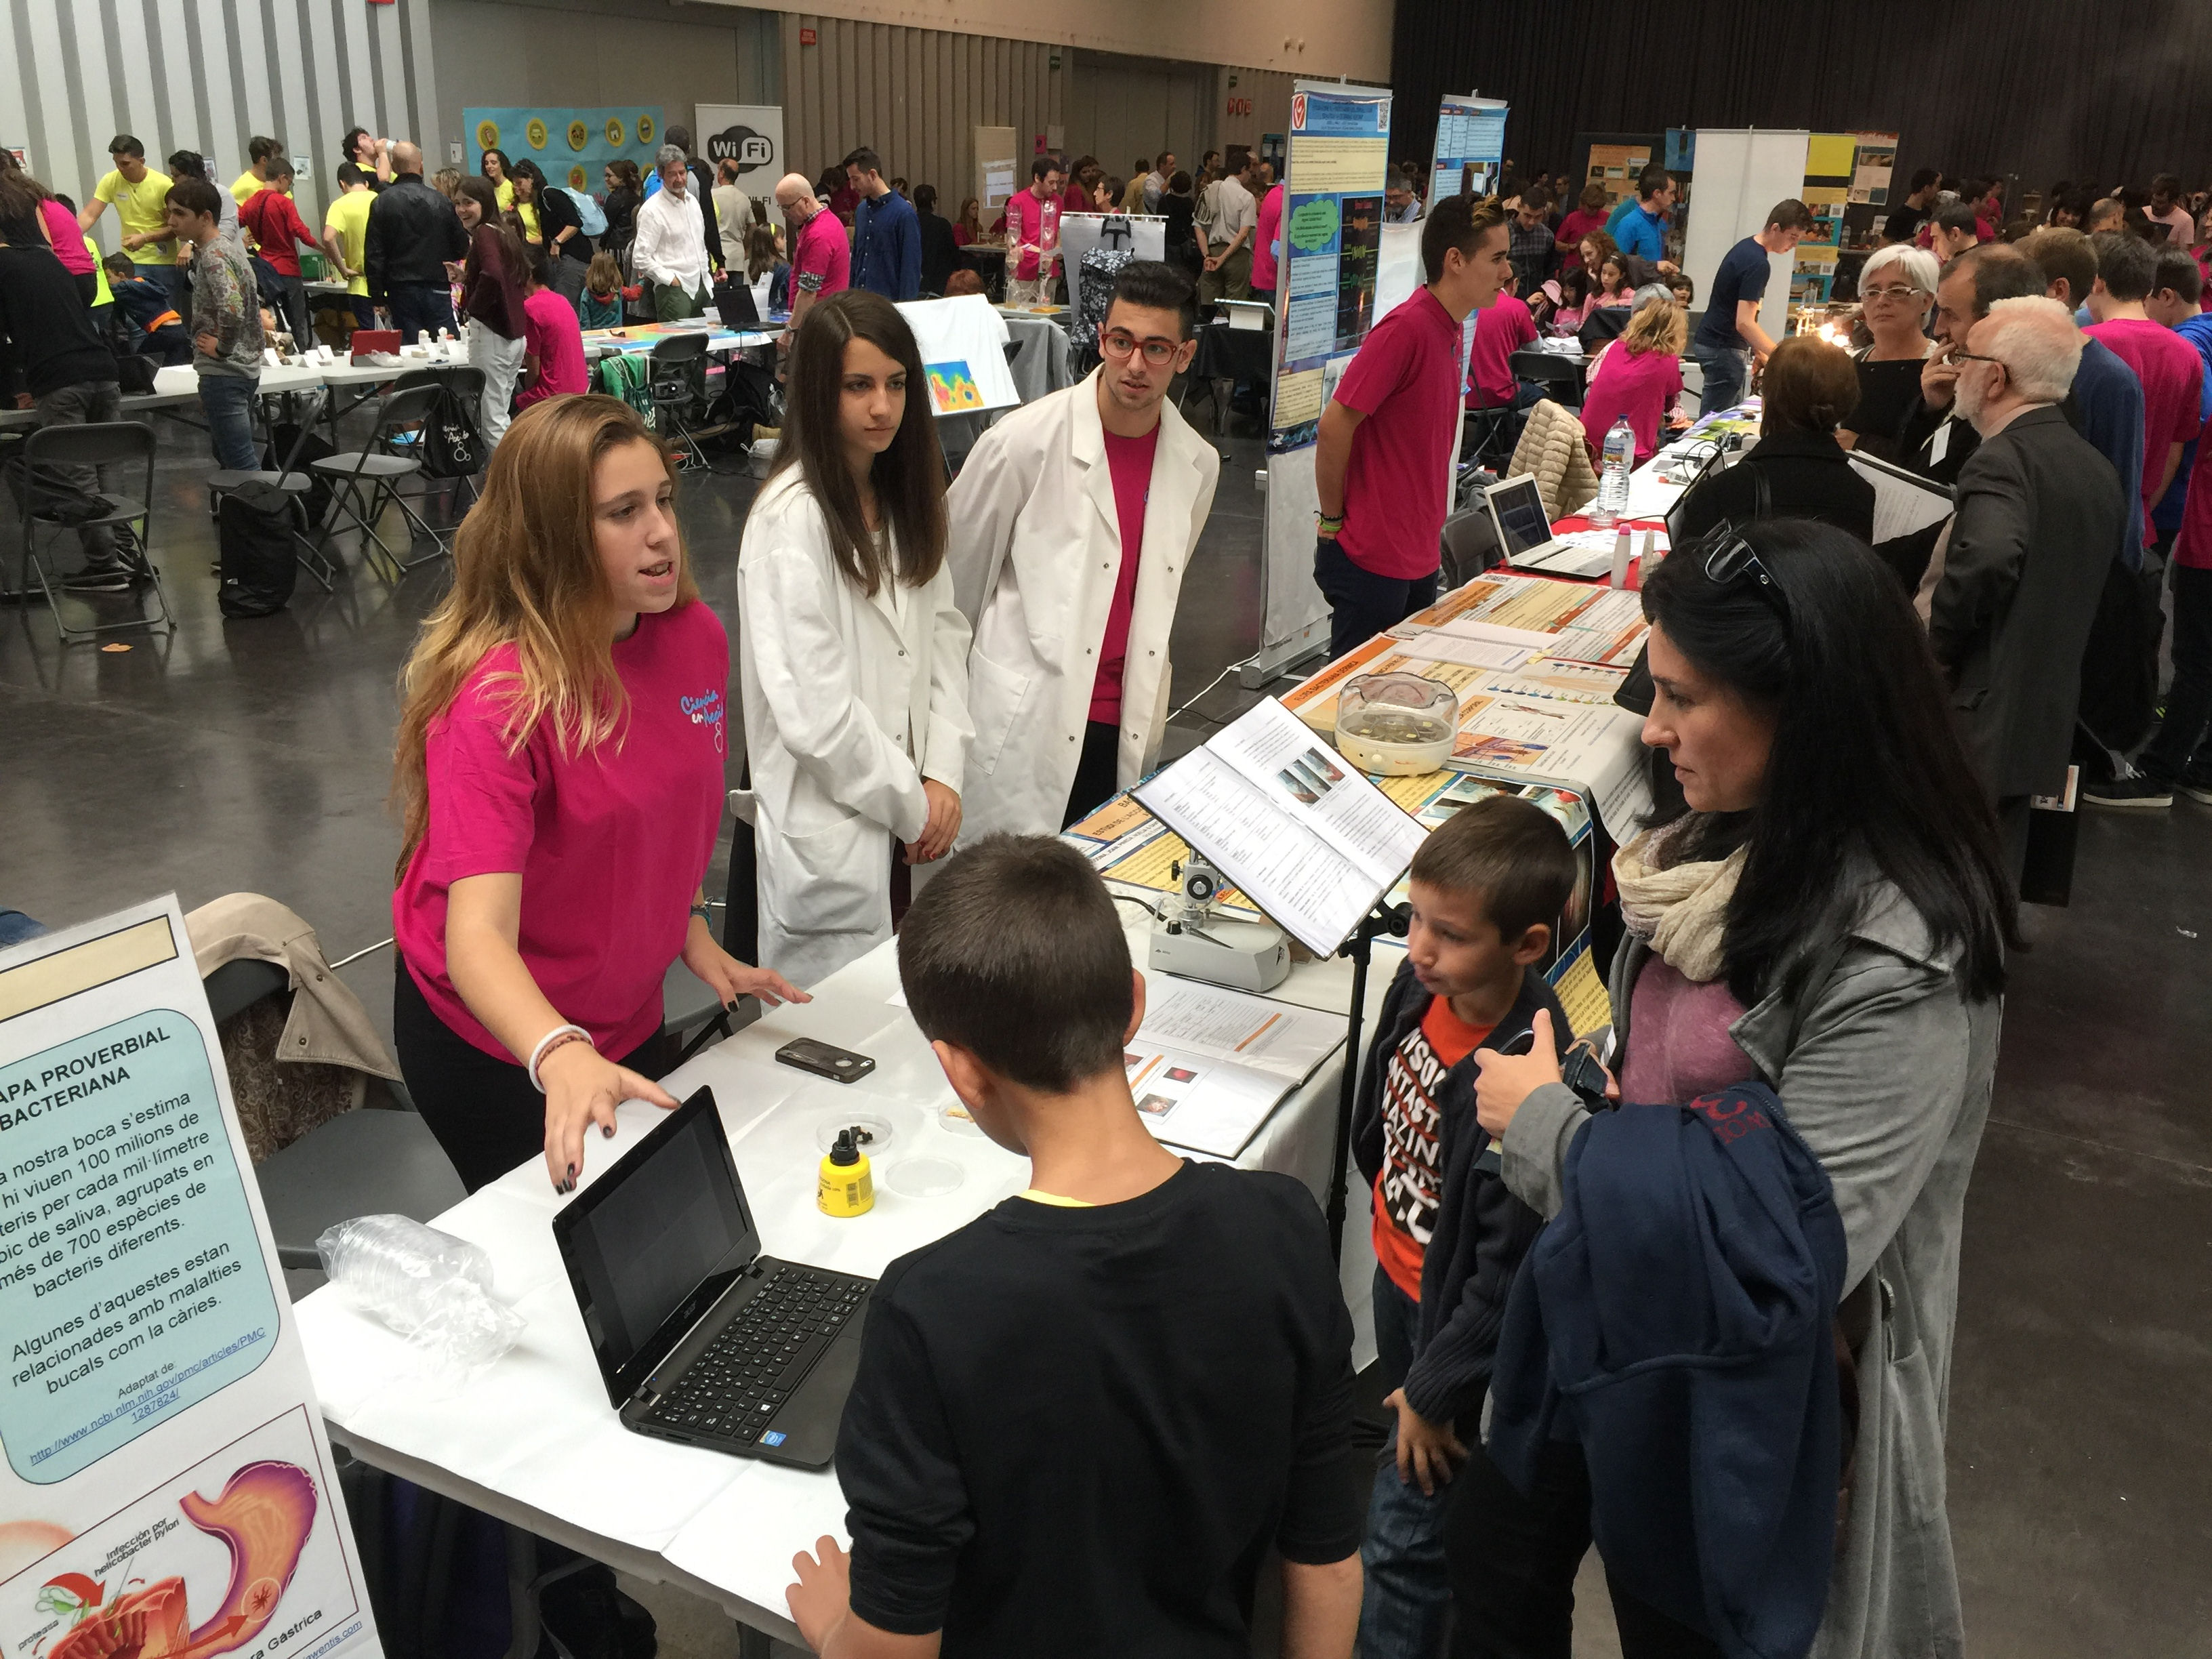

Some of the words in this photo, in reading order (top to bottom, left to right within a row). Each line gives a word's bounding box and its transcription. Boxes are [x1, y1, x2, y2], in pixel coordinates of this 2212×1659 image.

[0, 1079, 37, 1105] APA
[41, 1026, 171, 1088] PROVERBIAL
[0, 1066, 130, 1131] BACTERIANA
[0, 1172, 7, 1185] a
[12, 1144, 69, 1179] nostra
[73, 1124, 117, 1151] boca
[121, 1092, 191, 1130] s'estima
[2, 1189, 20, 1209] hi
[23, 1168, 73, 1198] viuen
[77, 1149, 110, 1173] 100
[115, 1124, 174, 1158] milions
[178, 1113, 199, 1130] de
[0, 1210, 37, 1237] teris
[41, 1194, 70, 1221] per
[76, 1173, 119, 1200] cada
[0, 1263, 37, 1290] més
[41, 1250, 64, 1267] de
[67, 1228, 101, 1254] 700
[106, 1193, 180, 1236] espècies
[185, 1181, 207, 1199] de
[28, 1231, 51, 1248] de
[56, 1204, 112, 1235] saliva,
[115, 1166, 188, 1207] agrupats
[193, 1154, 214, 1171] en
[33, 1255, 104, 1298] bacteris
[107, 1216, 184, 1261] diferents.
[12, 1315, 85, 1362] Algunes
[89, 1267, 180, 1319] d'aquestes
[184, 1242, 230, 1271] estan
[12, 1319, 124, 1388] relacionades
[129, 1298, 165, 1325] amb
[169, 1259, 242, 1304] malalties
[46, 1355, 104, 1394] bucals
[108, 1332, 146, 1361] com
[148, 1323, 165, 1340] la
[168, 1294, 222, 1328] càries.
[118, 1370, 159, 1399] Adaptat
[131, 1388, 180, 1425] 1287824/
[94, 1536, 152, 1577] helicobacter
[155, 1518, 180, 1540] pylori
[152, 1517, 168, 1534] por
[268, 1609, 323, 1650] Gástrica
